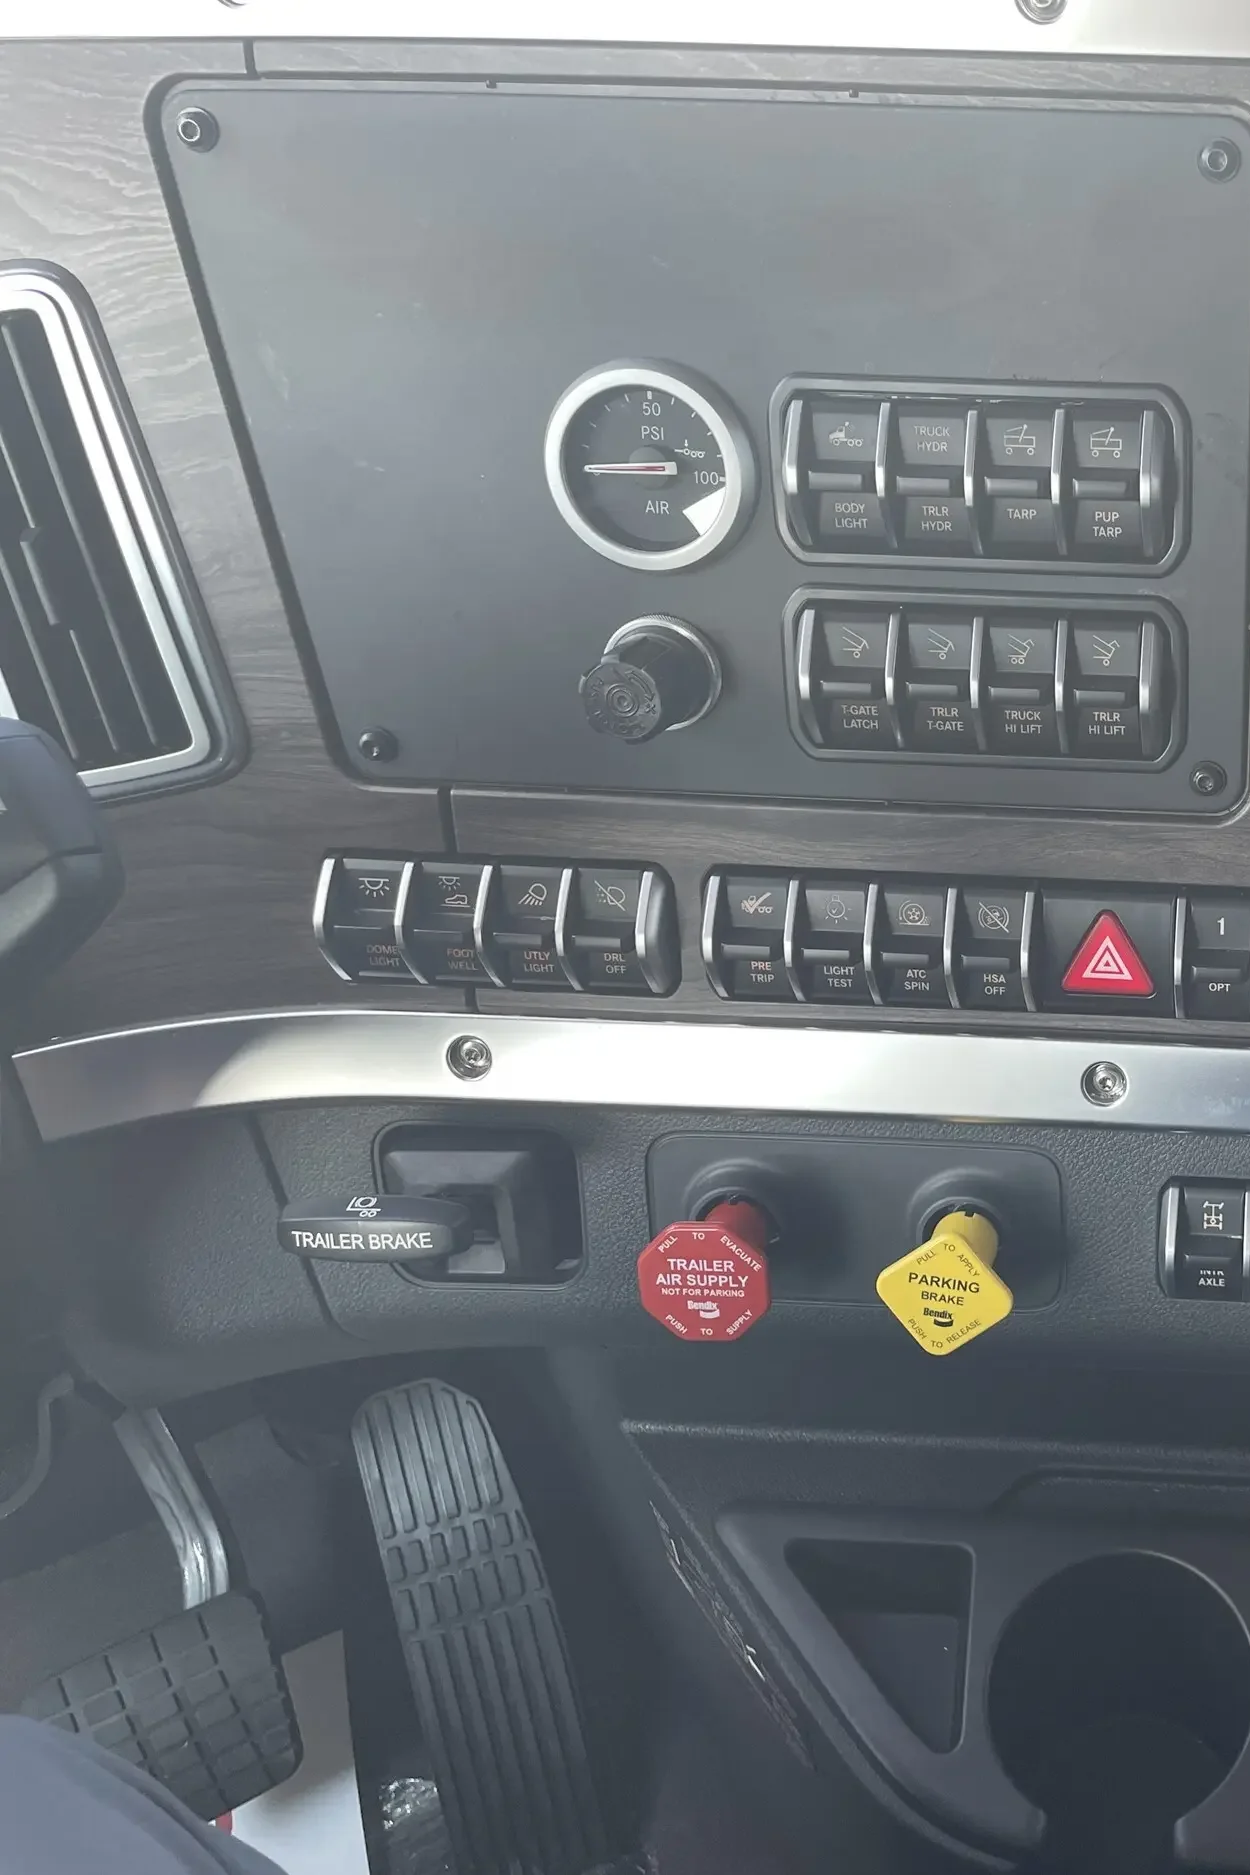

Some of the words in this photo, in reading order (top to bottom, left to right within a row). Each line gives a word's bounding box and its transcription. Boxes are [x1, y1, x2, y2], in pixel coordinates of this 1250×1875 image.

[641, 402, 661, 416] 50
[641, 425, 664, 440] PSI
[913, 425, 950, 438] TRUCK
[916, 440, 948, 453] HYDR
[694, 471, 719, 485] 100
[645, 500, 670, 515] AIR
[834, 502, 866, 515] BODY
[921, 505, 950, 517] TRLR
[1006, 508, 1038, 520] TARP
[1094, 511, 1119, 523] PUP
[835, 517, 868, 530] LIGHT
[921, 519, 953, 532] HYDR
[1093, 526, 1123, 538] TARP
[841, 704, 879, 717] T-GATE
[929, 706, 959, 718] TRLR
[1004, 710, 1042, 722] TRUCK
[1092, 711, 1121, 723] TRLR
[843, 718, 879, 731] LATCH
[927, 720, 965, 732] T-GATE
[1005, 723, 1018, 735] HI
[1020, 723, 1043, 735] LIFT
[1088, 725, 1101, 737] HI
[1103, 725, 1126, 737] LIFT
[1216, 917, 1225, 936] 1
[369, 956, 400, 967] LIGHT
[524, 951, 551, 962] UTLY
[604, 952, 626, 963] DRL
[447, 961, 479, 971] WELL
[524, 963, 555, 974] LIGHT
[605, 964, 627, 975] OFF
[751, 961, 772, 971] PRE
[823, 965, 855, 977] LIGHT
[750, 973, 775, 984] TRIP
[906, 969, 927, 979] ATC
[983, 973, 1006, 984] HSA
[827, 977, 853, 988] TEST
[904, 981, 930, 991] SPIN
[1208, 982, 1231, 993] OPT
[984, 985, 1006, 996] OFF
[291, 1230, 365, 1250] TRAILER
[368, 1232, 433, 1250] BRAKE
[658, 1235, 679, 1254] PULL
[692, 1232, 705, 1241] TO
[720, 1235, 762, 1272] EVACUATE
[667, 1258, 735, 1273] TRAILER
[916, 1250, 937, 1266] PULL
[943, 1243, 956, 1252] TO
[957, 1254, 981, 1278] APPLY
[656, 1273, 683, 1286] AIR
[686, 1274, 749, 1288] SUPPLY
[908, 1272, 981, 1294] PARKING
[1198, 1277, 1226, 1287] AXLE
[661, 1287, 681, 1296] NOT
[682, 1288, 702, 1297] FOR
[703, 1289, 746, 1298] PARKING
[921, 1290, 965, 1307] BRAKE
[687, 1300, 719, 1310] Bendix
[923, 1307, 954, 1321] Bendix
[665, 1314, 688, 1335] PUSH
[700, 1328, 714, 1337] TO
[726, 1309, 754, 1336] SUPPLY
[907, 1318, 928, 1340] PUSH
[931, 1340, 944, 1349] TO
[946, 1319, 982, 1345] RELEASE
